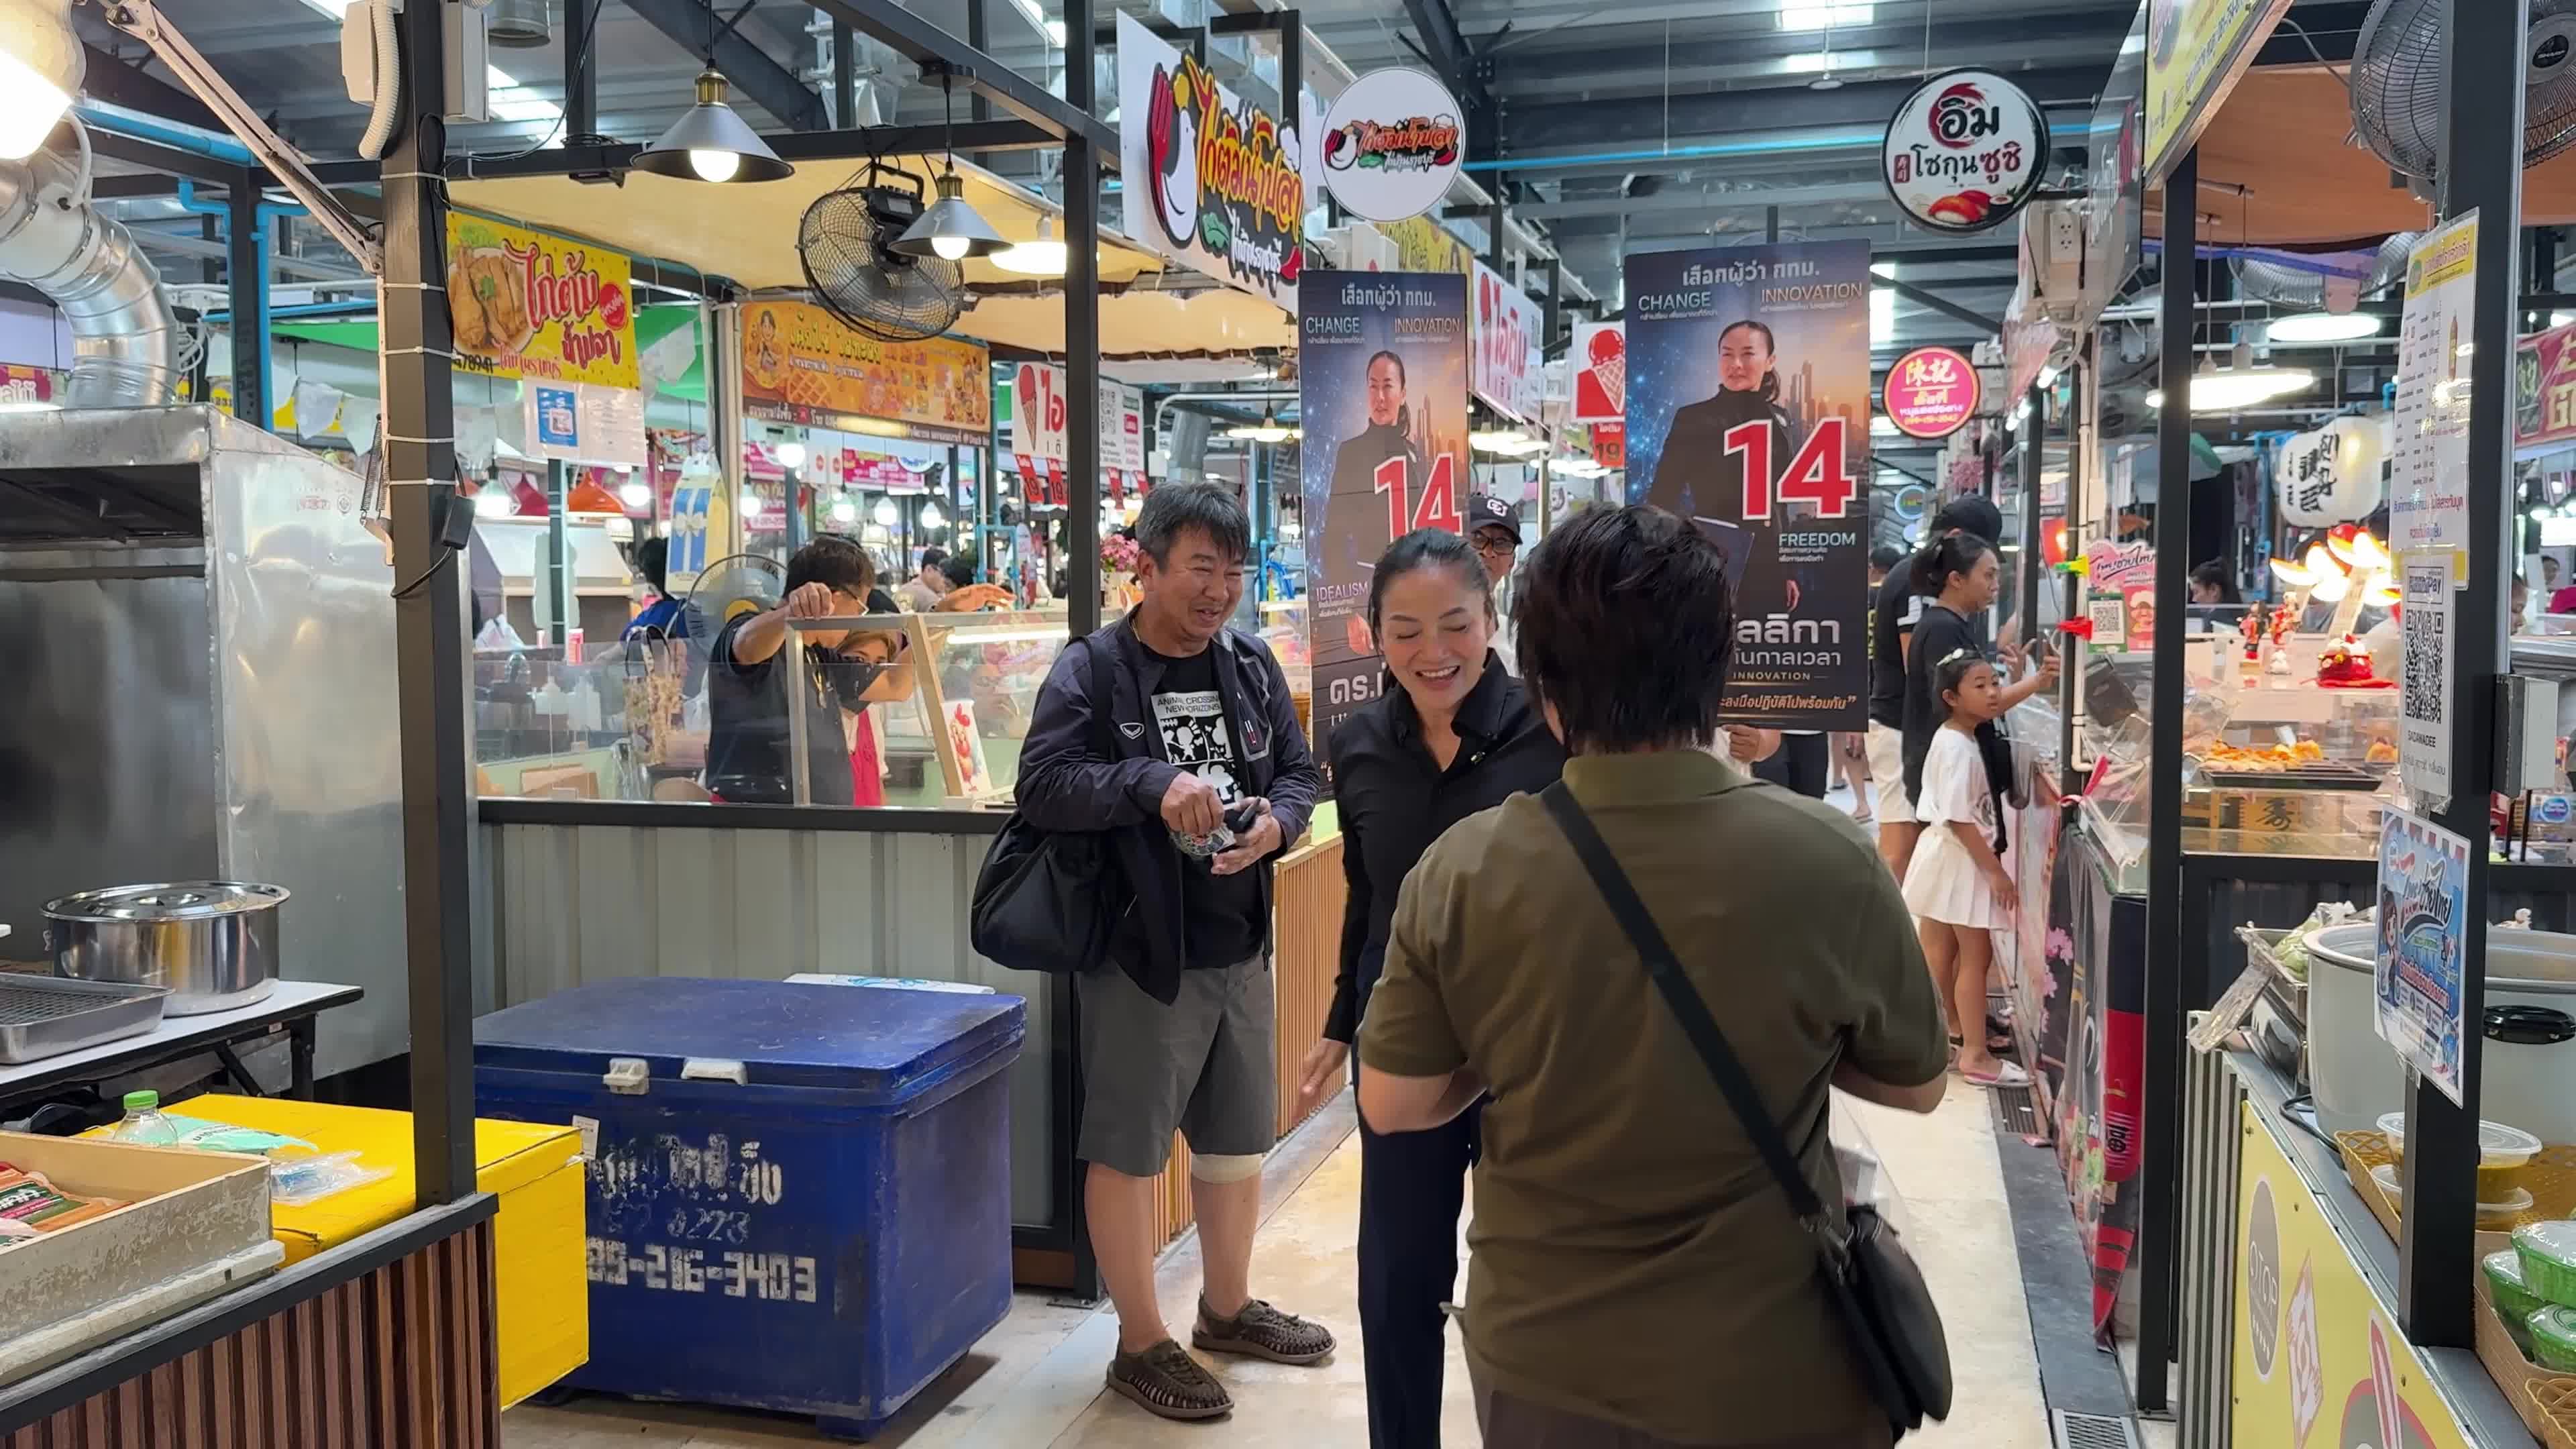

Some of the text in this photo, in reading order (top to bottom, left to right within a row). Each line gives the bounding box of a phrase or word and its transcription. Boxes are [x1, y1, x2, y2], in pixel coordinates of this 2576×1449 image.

[1682, 260, 1765, 288] เลือกผู้ว่า
[1342, 282, 1401, 311] เลือกผู้ว่า
[1638, 291, 1711, 311] CHANGE
[1762, 282, 1862, 303] INNOVATION
[1306, 317, 1360, 334] CHANGE
[1395, 317, 1460, 333] INNOVATION
[1595, 443, 1620, 463] 19
[1723, 416, 1856, 520] 14
[1025, 477, 1038, 494] 19
[1051, 482, 1063, 500] 19
[1374, 452, 1463, 543] 14
[1778, 532, 1856, 546] FREEDOM
[1316, 581, 1368, 602] IDEALISM
[1737, 613, 1840, 643] ลลิกา
[1733, 672, 1810, 680] INNOVATION
[1166, 705, 1185, 714] NEW
[1185, 695, 1219, 704] CROSSIN
[2250, 1240, 2278, 1316] OTOP
